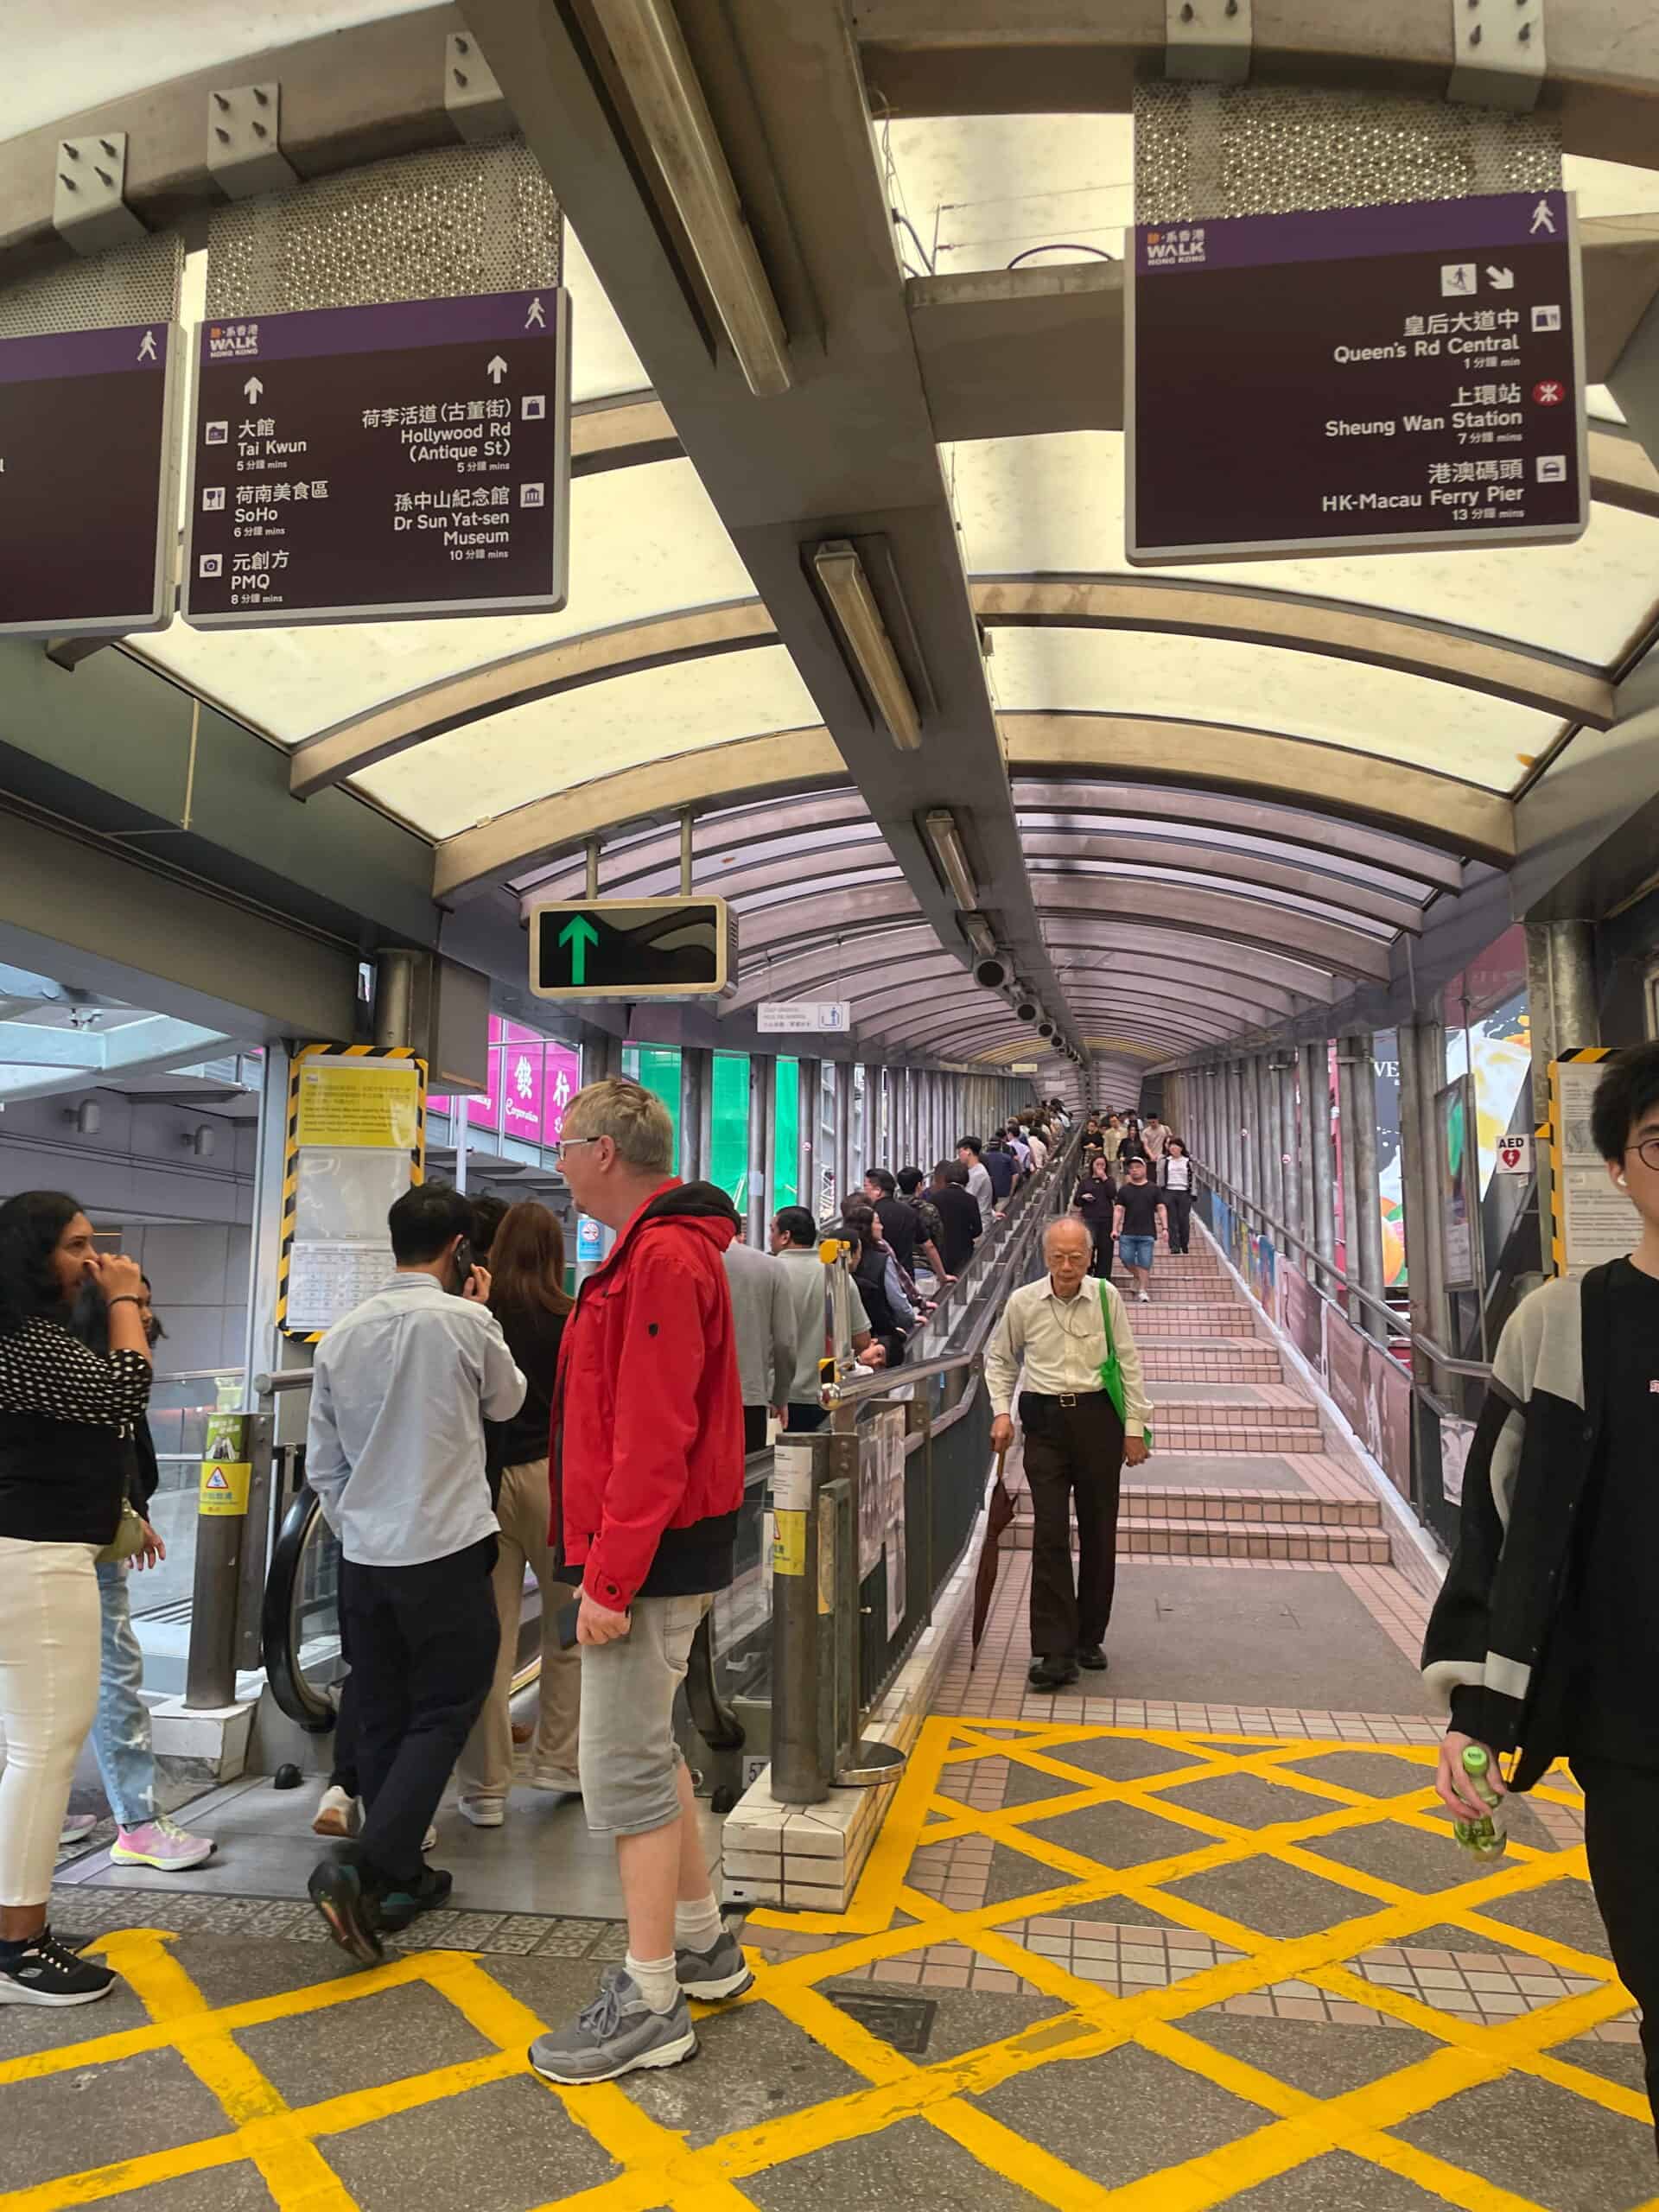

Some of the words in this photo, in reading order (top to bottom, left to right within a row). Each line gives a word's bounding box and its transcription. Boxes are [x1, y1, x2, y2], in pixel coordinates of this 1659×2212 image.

[1147, 242, 1204, 258] WALK
[1147, 257, 1175, 266] HONG
[1178, 255, 1205, 264] KONG
[1403, 308, 1519, 336] 皇后大道中
[210, 335, 257, 351] WALK
[1334, 342, 1407, 364] Queen's
[1414, 340, 1440, 357] Rd
[1447, 334, 1521, 354] Central
[1464, 358, 1470, 369] 1
[1501, 358, 1521, 367] min
[1450, 383, 1521, 407] 上環站
[238, 417, 276, 439] 大館
[1325, 419, 1395, 437] Sheung
[1403, 415, 1445, 432] Wan
[1452, 410, 1522, 429] Station
[401, 423, 483, 444] Hollywood
[490, 422, 512, 438] Rd
[1458, 433, 1467, 445] 7
[1497, 433, 1522, 442] mins
[238, 442, 259, 457] Tai
[265, 440, 307, 455] Kwun
[410, 444, 477, 463] (Antique
[484, 438, 511, 456] St)
[237, 461, 245, 471] 5
[267, 461, 288, 469] mins
[457, 462, 465, 473] 5
[489, 461, 511, 471] mins
[1427, 458, 1523, 485] 港澳碼頭
[235, 480, 329, 505] 荷南美食區
[394, 486, 510, 512] 孫中山紀念館
[1322, 493, 1421, 512] HK-Macau
[1430, 488, 1479, 506] Ferry
[1487, 486, 1524, 503] Pier
[235, 507, 278, 523] SoHo
[394, 516, 413, 531] Dr
[417, 514, 448, 530] Sun
[451, 512, 509, 527] Yat-sen
[1452, 509, 1467, 521] 13
[1499, 509, 1525, 518] mins
[233, 527, 242, 537] 6
[264, 527, 286, 536] mins
[444, 531, 509, 546] Museum
[232, 550, 289, 571] 元創方
[450, 550, 463, 561] 10
[487, 550, 509, 559] mins
[231, 574, 270, 590] PMQ
[231, 594, 238, 605] 8
[263, 594, 283, 603] mins
[1498, 1137, 1524, 1148] AED
